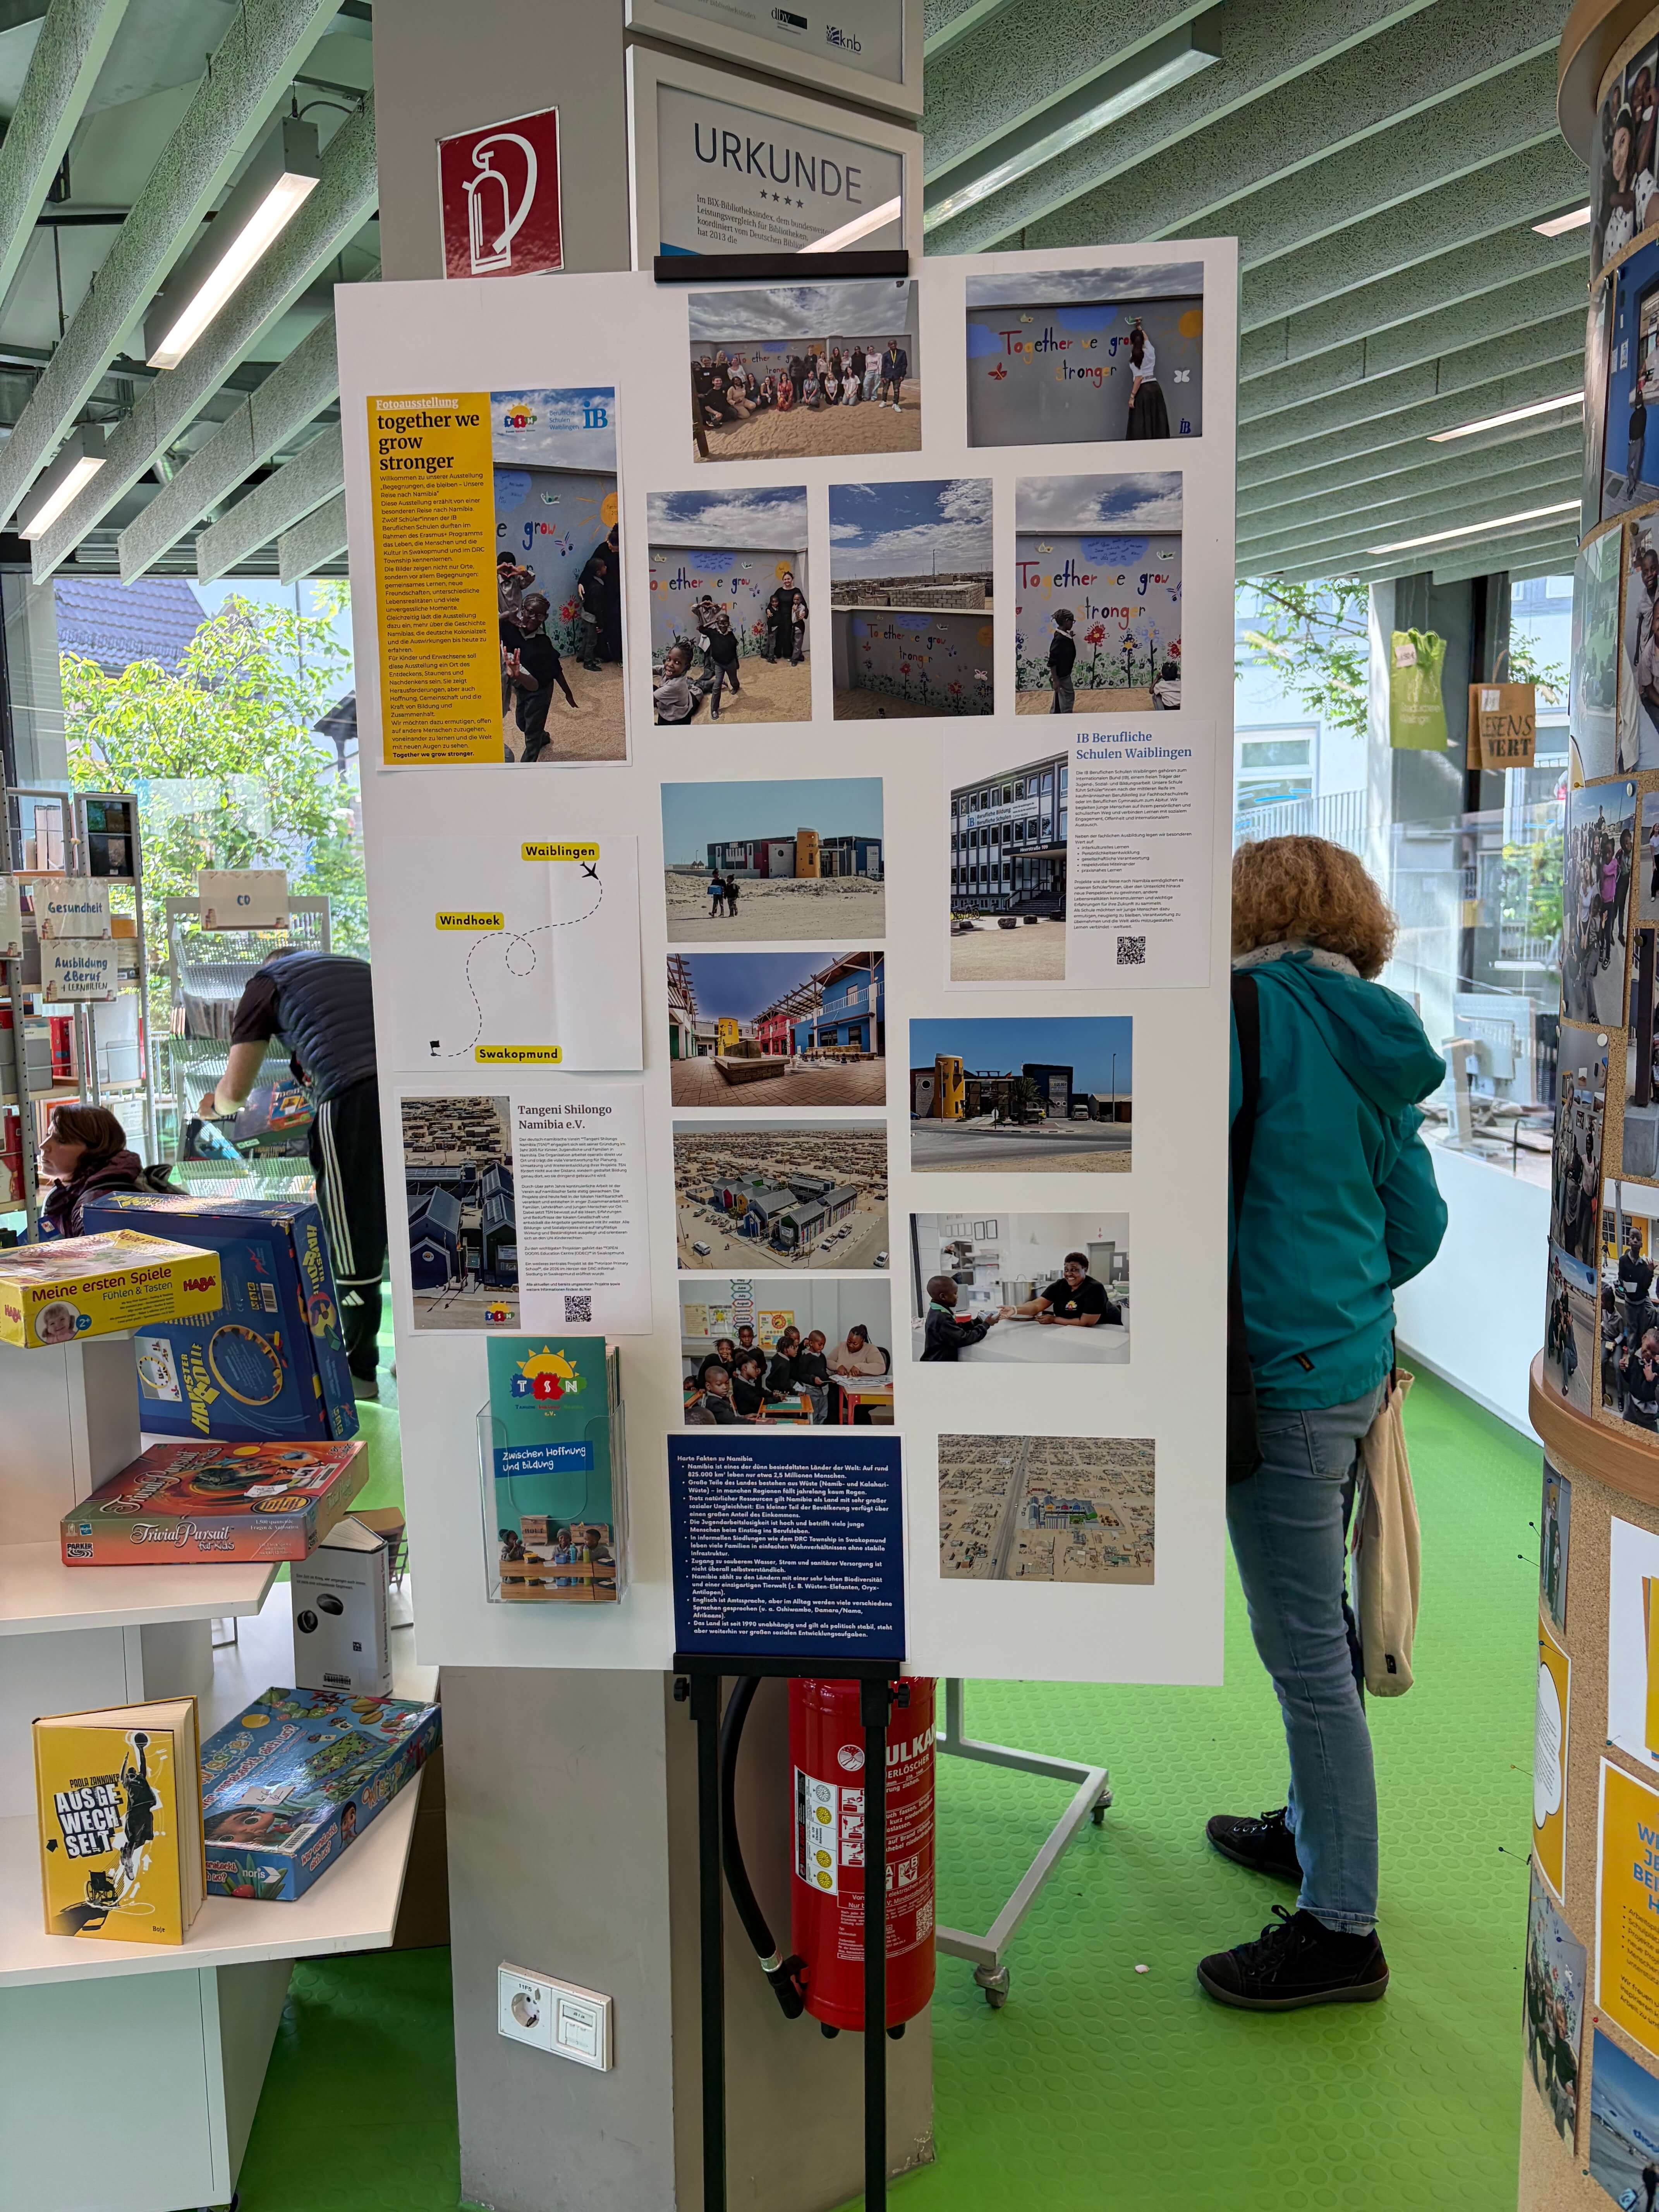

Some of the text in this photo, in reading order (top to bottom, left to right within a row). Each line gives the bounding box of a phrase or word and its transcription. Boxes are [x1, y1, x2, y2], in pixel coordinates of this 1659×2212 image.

[840, 30, 861, 52] knb
[695, 123, 862, 204] URKUNDE
[697, 194, 706, 204] Im
[708, 197, 775, 222] BIX-Bibliotheksindex,
[776, 215, 790, 226] dem
[697, 206, 808, 241] Leistungsvergleich für Bibliotheken,
[697, 217, 733, 233] koordiniert
[735, 227, 748, 236] vom
[750, 230, 782, 245] Deutschen
[697, 228, 737, 244] hat 2013 die
[999, 327, 1073, 364] Together
[1109, 337, 1130, 356] gro
[1055, 359, 1116, 388] stronger
[376, 397, 459, 410] Fotoausstellung
[378, 412, 479, 433] together we
[379, 437, 423, 455] grow
[380, 456, 454, 474] stronger
[523, 521, 556, 550] grow
[731, 578, 750, 594] grow
[1015, 559, 1097, 600] Together
[1138, 573, 1170, 595] grow
[1077, 596, 1146, 630] stronger
[927, 636, 946, 650] grow
[1077, 731, 1152, 743] IB Berufliche
[1077, 747, 1192, 760] Schulen Waiblingen
[1488, 738, 1530, 757] WERT
[996, 807, 1011, 816] Bildung
[977, 817, 995, 826] Berufliche
[526, 846, 595, 859] Waiblingen
[48, 902, 102, 913] Gesundheit
[237, 895, 251, 906] CD
[440, 915, 500, 925] Windhoek
[55, 957, 107, 970] Ausbildung
[479, 1049, 558, 1061] Swakopmund
[518, 1104, 612, 1117] Tangeni Shilongo
[519, 1120, 586, 1129] Namibia e.V.
[32, 1267, 172, 1302] Meine ersten Spiele
[103, 1288, 133, 1301] Fühlen
[144, 1281, 172, 1292] Tasten
[183, 1275, 216, 1292] HABA
[79, 1318, 90, 1328] 2+
[546, 1446, 586, 1456] Hoffnung
[522, 1460, 554, 1470] Bildung
[130, 1516, 230, 1548] Trivial Pursuit
[198, 1541, 210, 1551] für
[887, 1753, 929, 1779] ERLÖSCHER
[70, 1777, 89, 1788] PAOLA
[56, 1783, 120, 1813] AUSGE
[60, 1806, 118, 1834] WECH
[890, 1817, 903, 1825] kurz
[242, 1867, 266, 1879] noris
[1628, 1928, 1654, 1951] Projekte
[518, 1983, 532, 1992] 11F5
[1632, 1984, 1654, 2004] freuen
